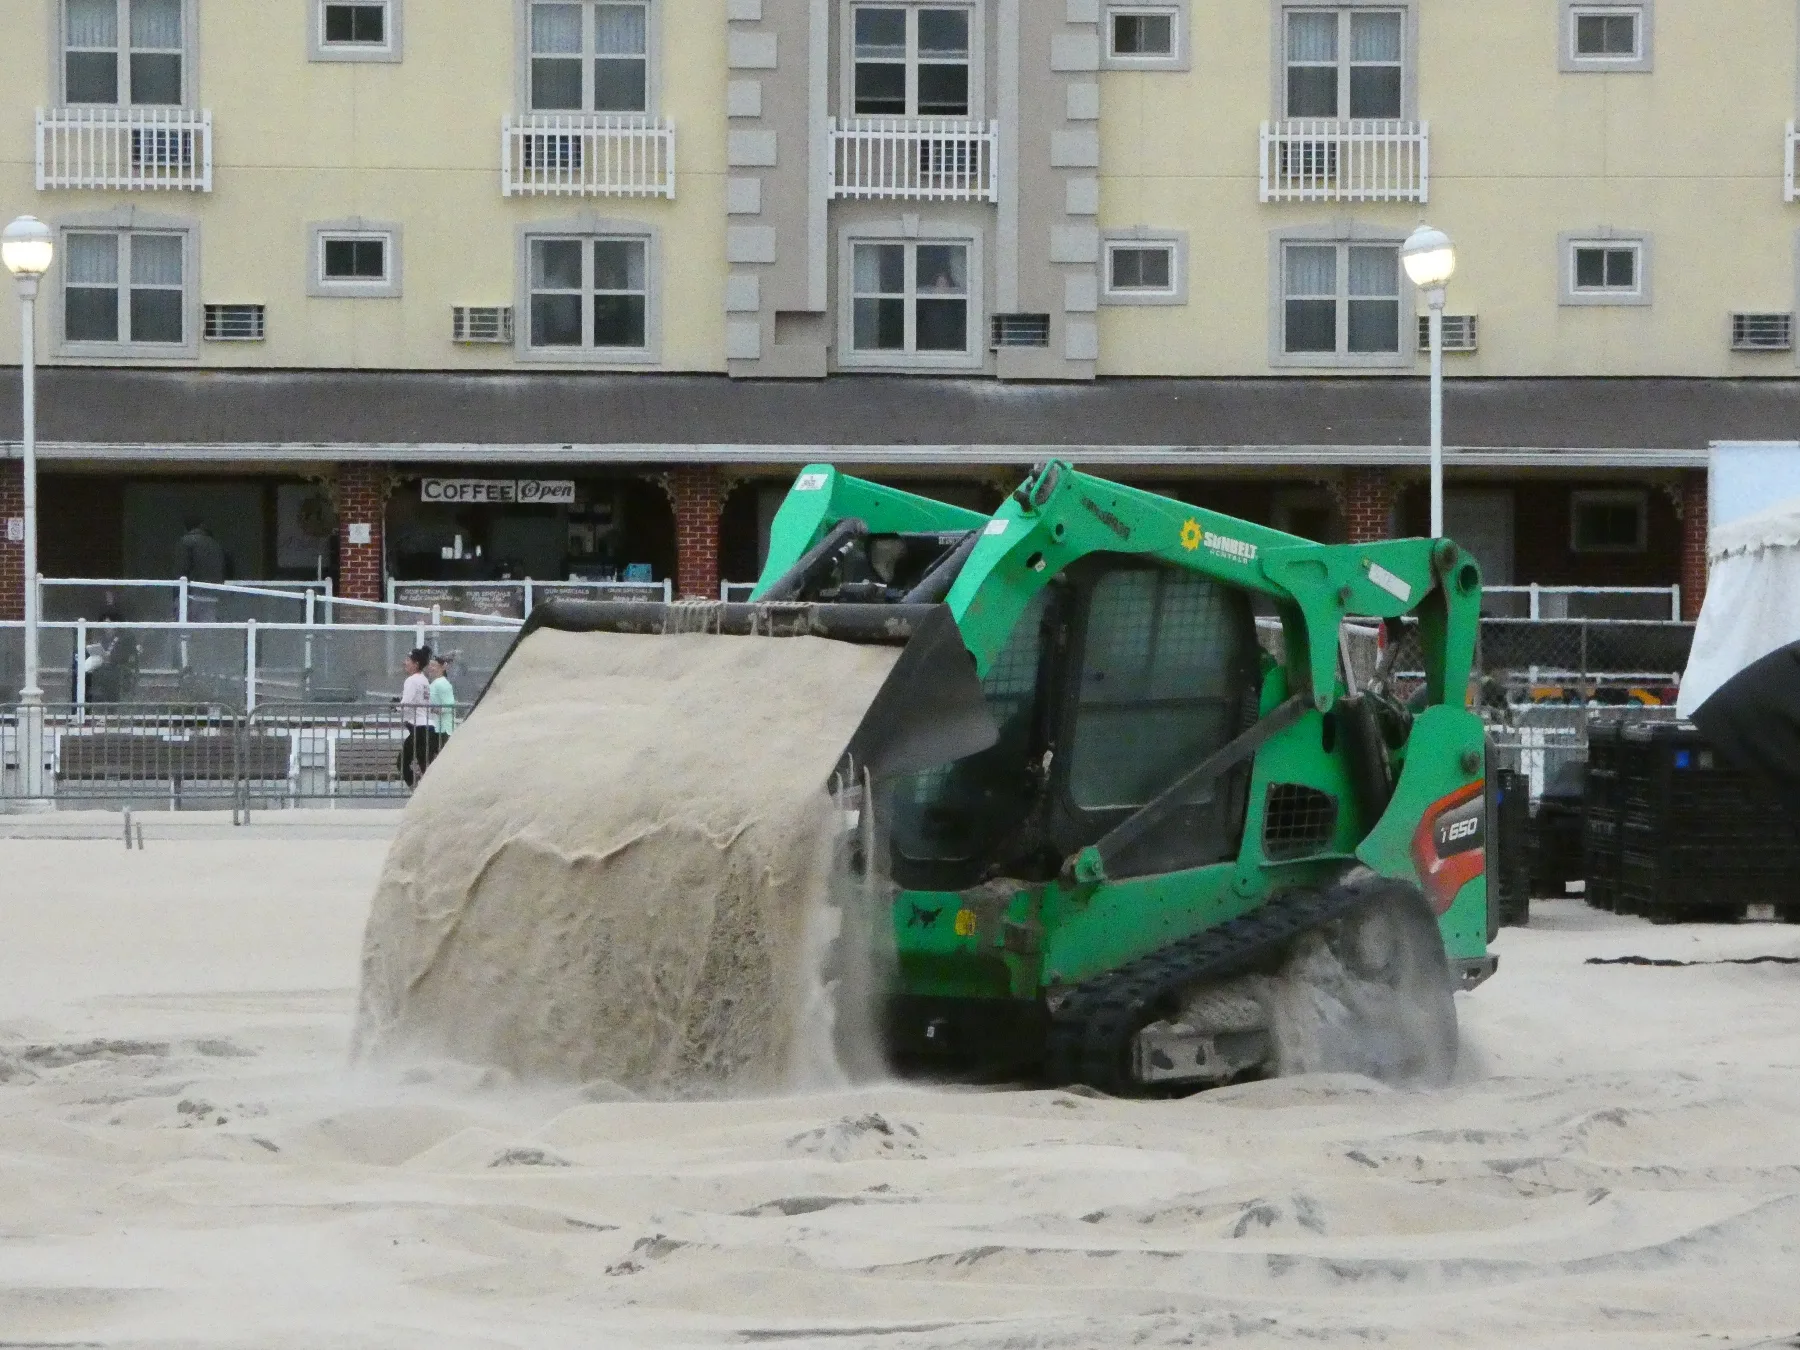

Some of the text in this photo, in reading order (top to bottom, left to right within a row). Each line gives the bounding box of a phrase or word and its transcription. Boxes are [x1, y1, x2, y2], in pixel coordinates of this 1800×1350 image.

[424, 480, 513, 500] COFFEE
[521, 480, 572, 500] Open
[1204, 532, 1257, 559] SUNBELT
